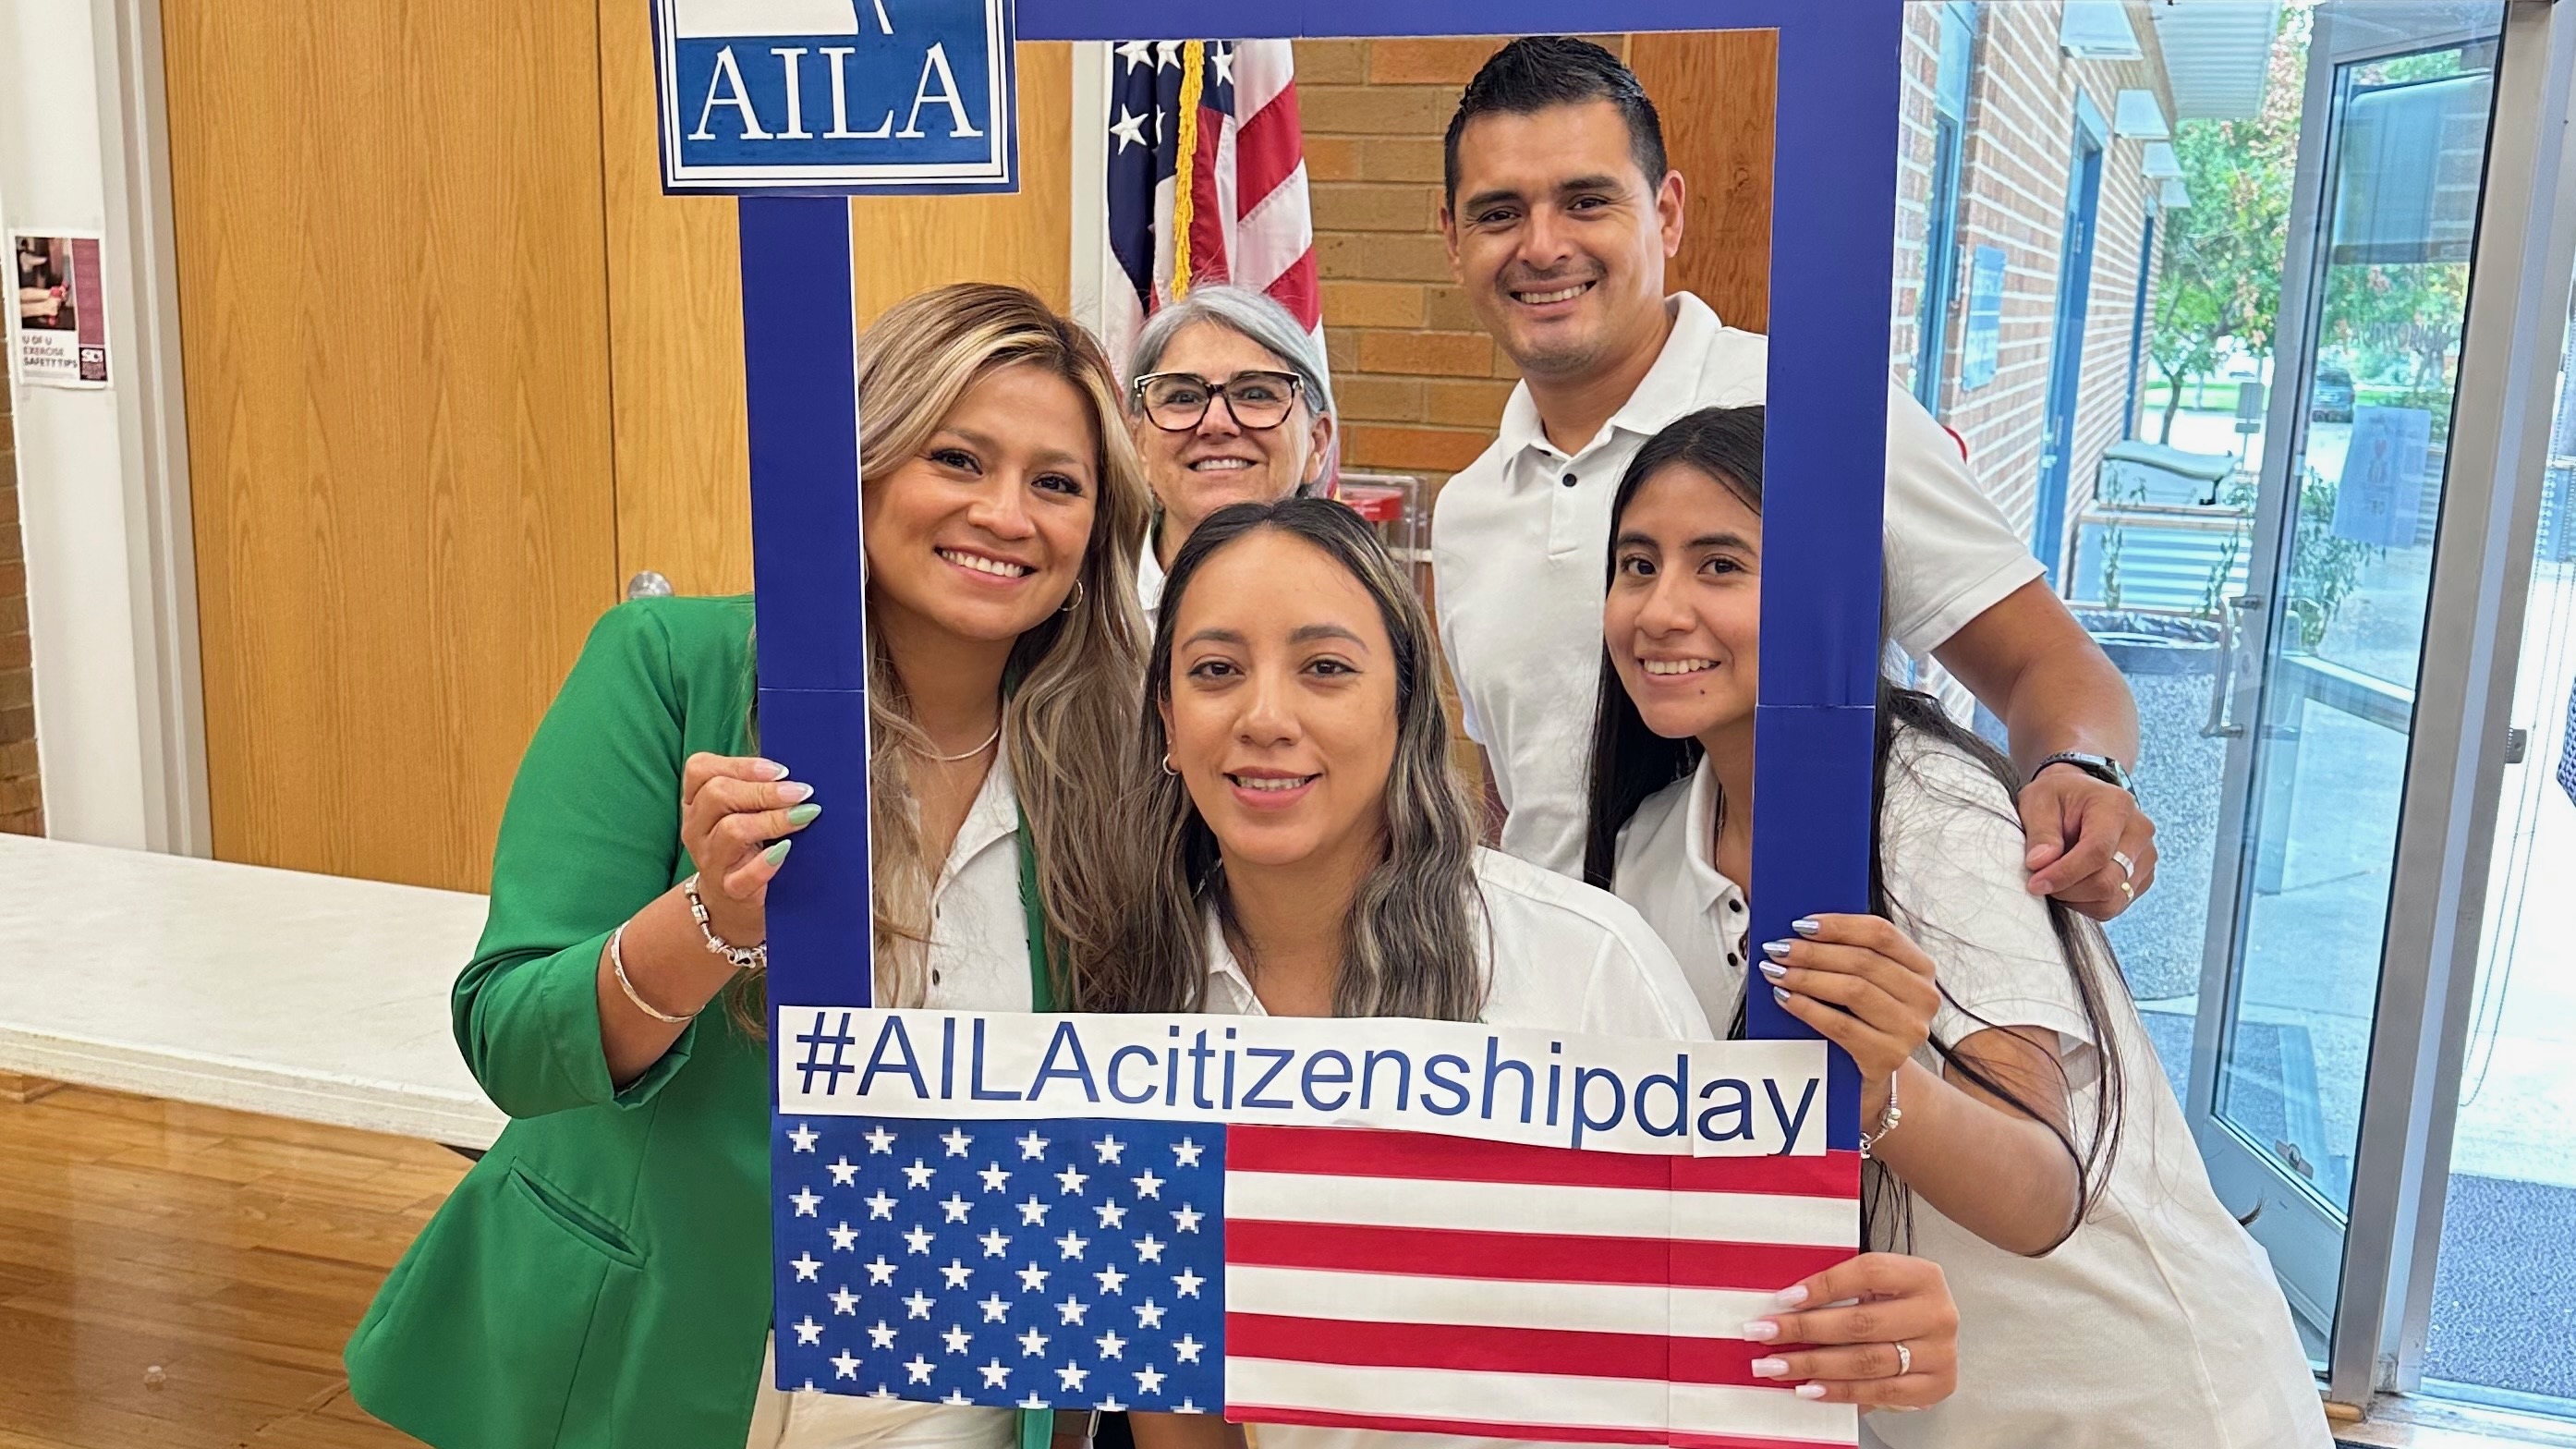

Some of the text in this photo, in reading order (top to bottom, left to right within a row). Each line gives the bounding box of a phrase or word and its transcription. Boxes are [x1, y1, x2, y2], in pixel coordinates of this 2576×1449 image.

[687, 42, 984, 140] AILA
[22, 335, 30, 344] U
[45, 336, 53, 346] U
[23, 346, 64, 356] EXERCISE
[23, 357, 56, 367] SAFETY
[796, 1011, 1820, 1155] #AILAcitizenshipday
